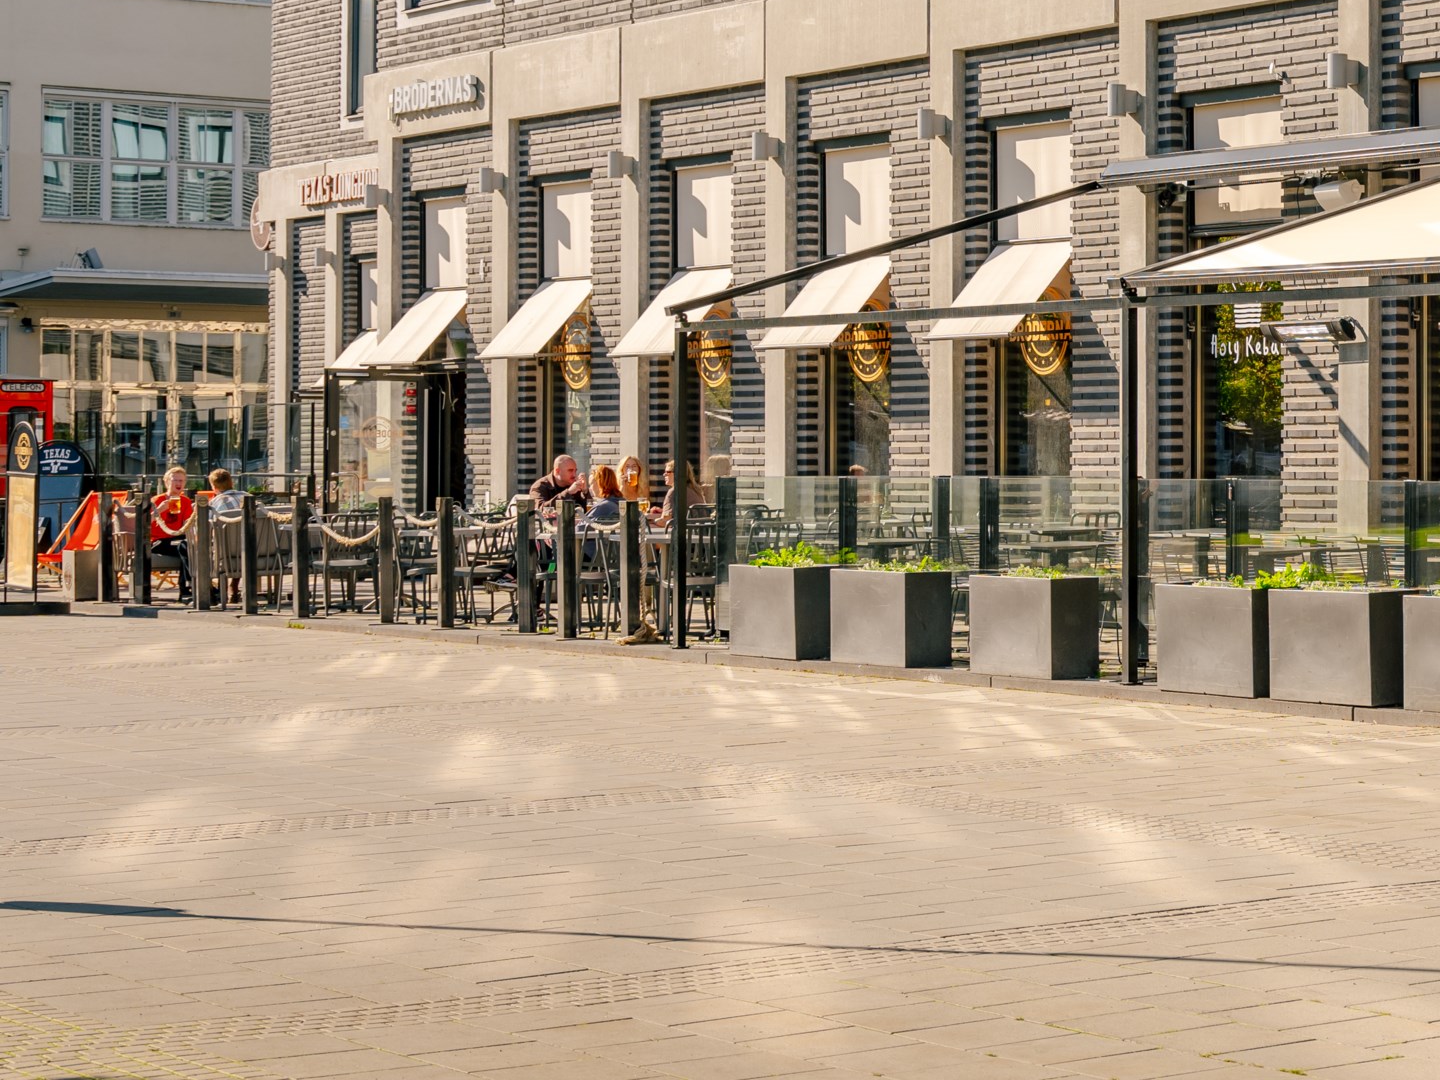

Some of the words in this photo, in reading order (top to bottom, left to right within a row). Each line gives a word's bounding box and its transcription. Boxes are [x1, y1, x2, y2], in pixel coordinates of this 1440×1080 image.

[299, 174, 332, 206] TEXAS
[1210, 333, 1240, 365] Holy
[1245, 334, 1284, 358] Keba
[5, 383, 42, 392] TELEFON
[43, 448, 71, 459] TEXAS
